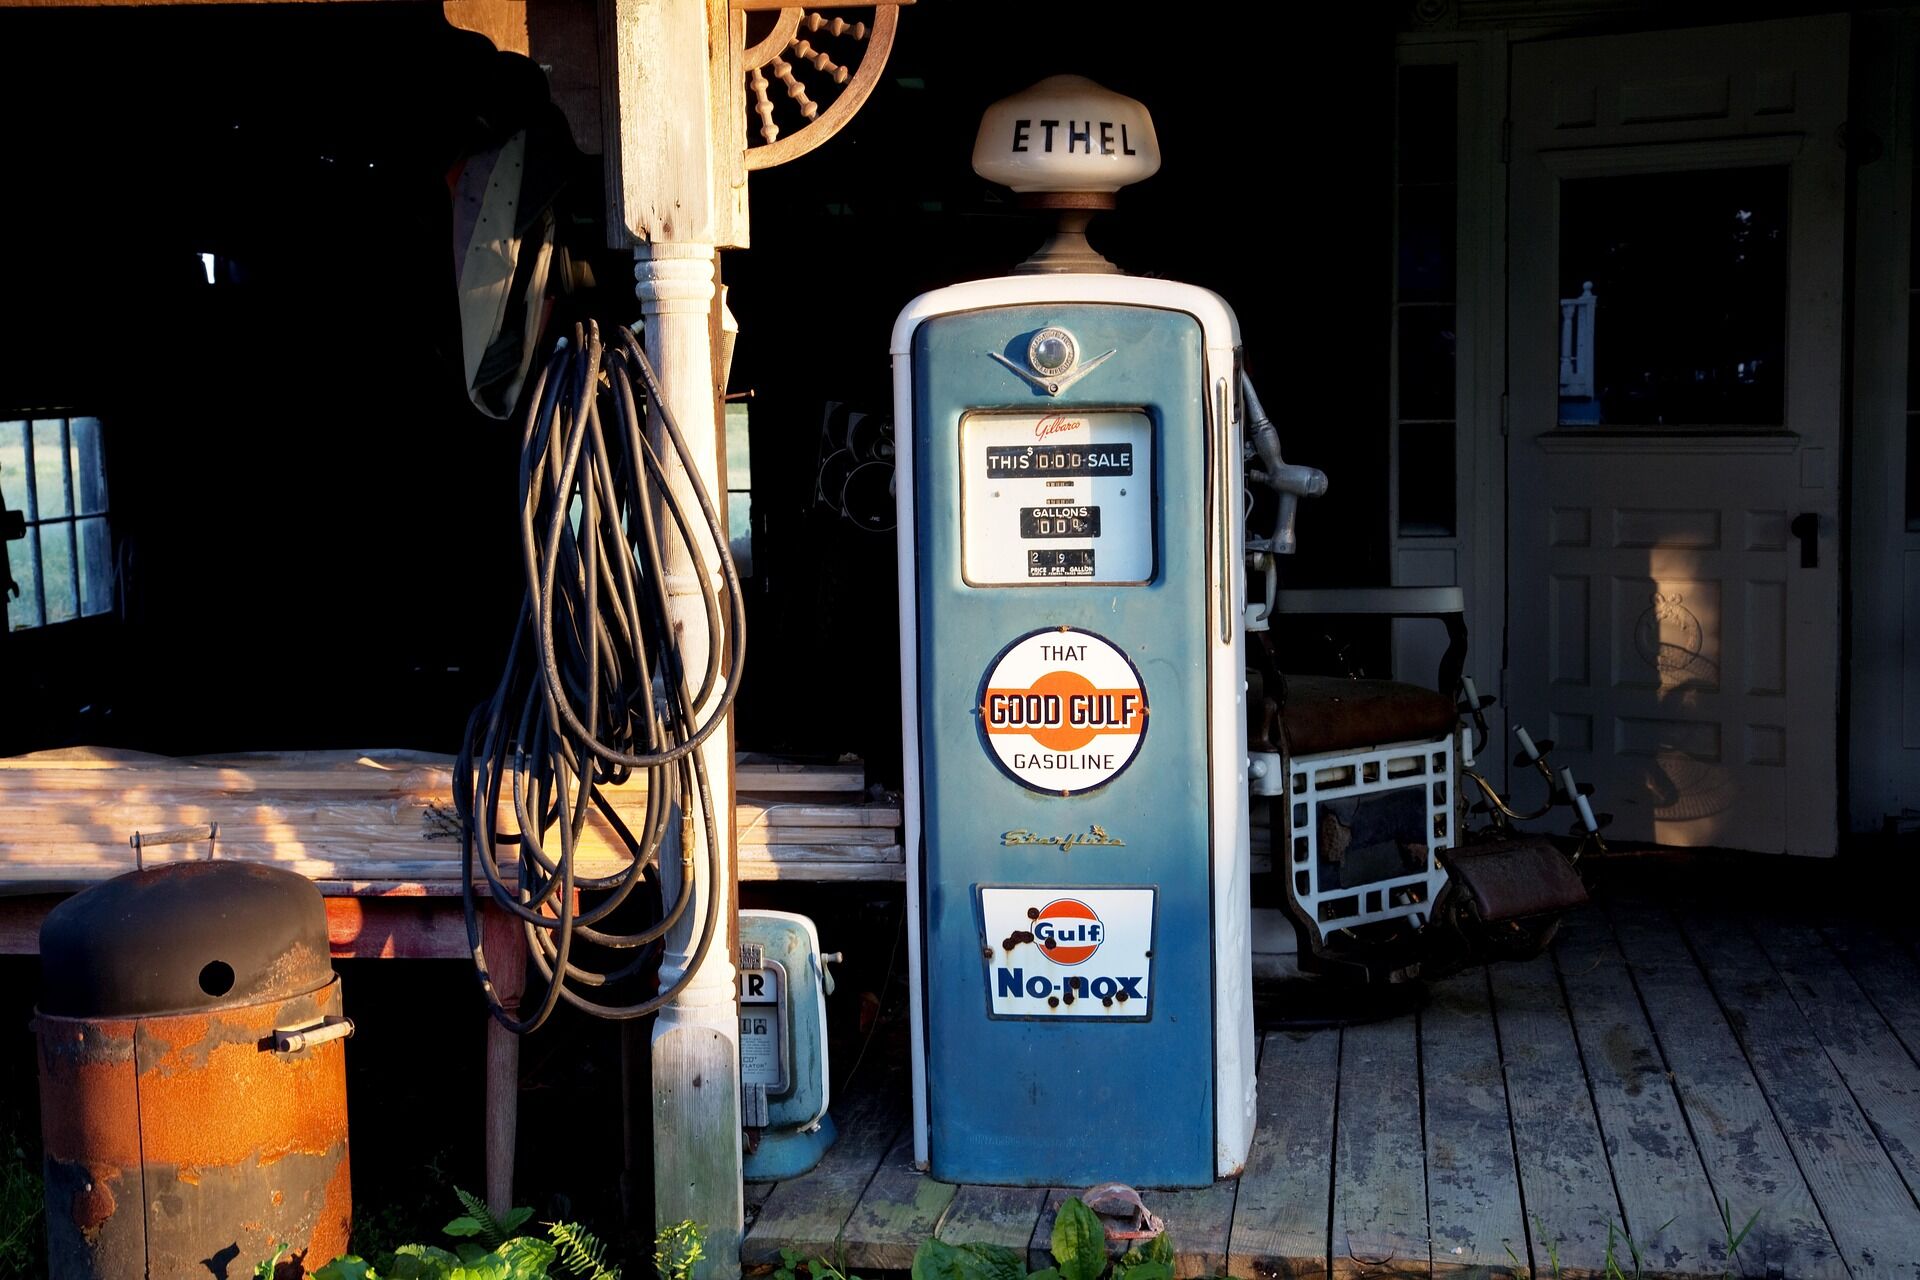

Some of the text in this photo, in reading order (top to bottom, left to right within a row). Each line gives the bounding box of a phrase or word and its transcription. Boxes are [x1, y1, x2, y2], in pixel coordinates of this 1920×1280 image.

[1012, 120, 1136, 156] ETHEL
[1035, 414, 1081, 441] Gilbarco
[989, 455, 1029, 470] THIS
[1088, 453, 1130, 467] SALE
[1033, 507, 1088, 517] GALLONS
[1040, 645, 1087, 661] THAT
[990, 694, 1139, 728] GOOD GULF
[1014, 753, 1115, 770] GASOLINE
[1034, 922, 1101, 942] Gulf
[739, 973, 765, 997] IR
